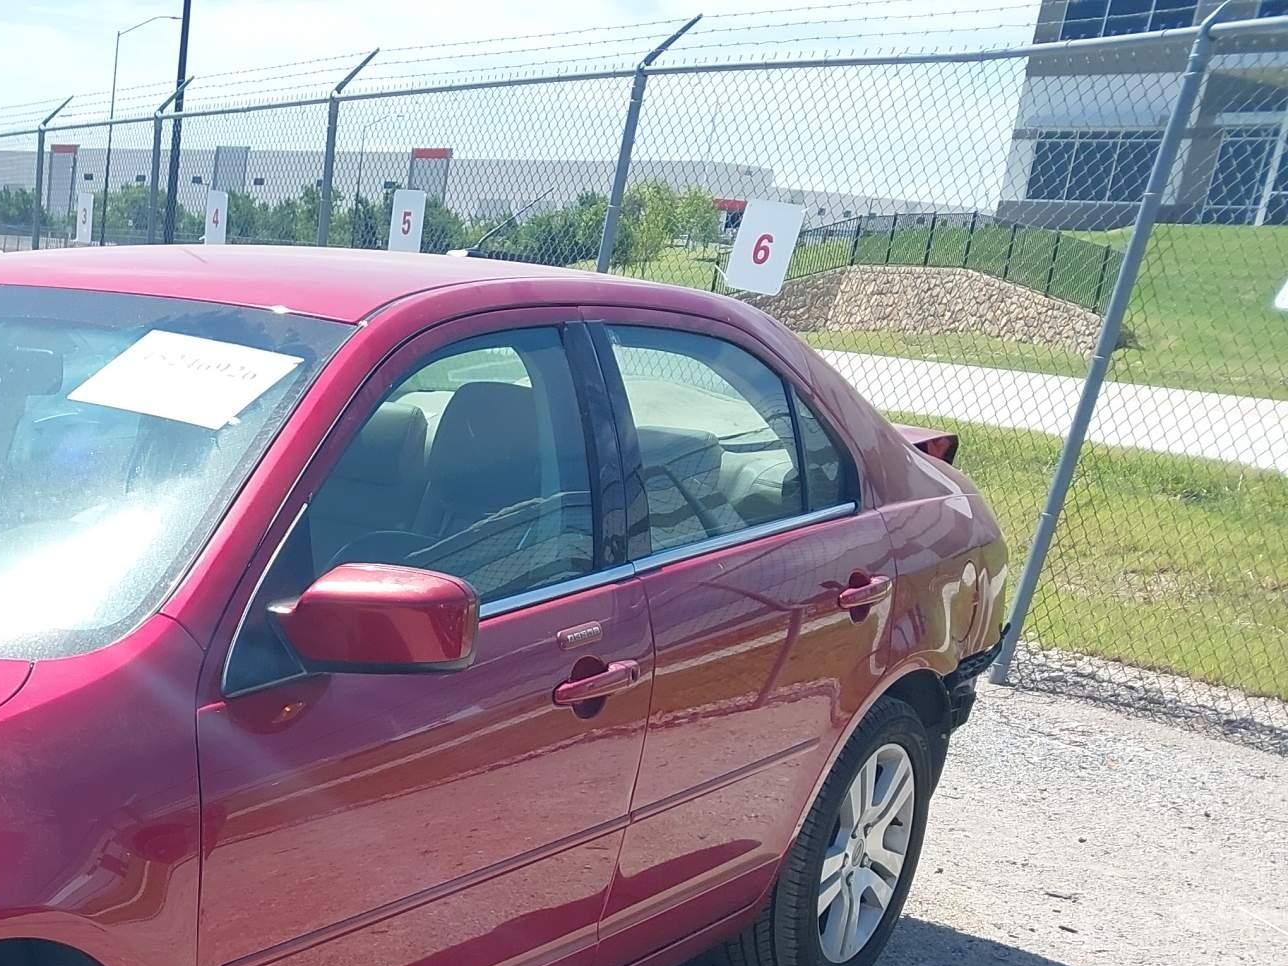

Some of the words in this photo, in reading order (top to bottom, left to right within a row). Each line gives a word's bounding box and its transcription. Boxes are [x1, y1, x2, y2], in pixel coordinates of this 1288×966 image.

[81, 207, 88, 225] 3
[212, 208, 219, 229] 4
[401, 211, 412, 235] 5
[752, 233, 774, 265] 6
